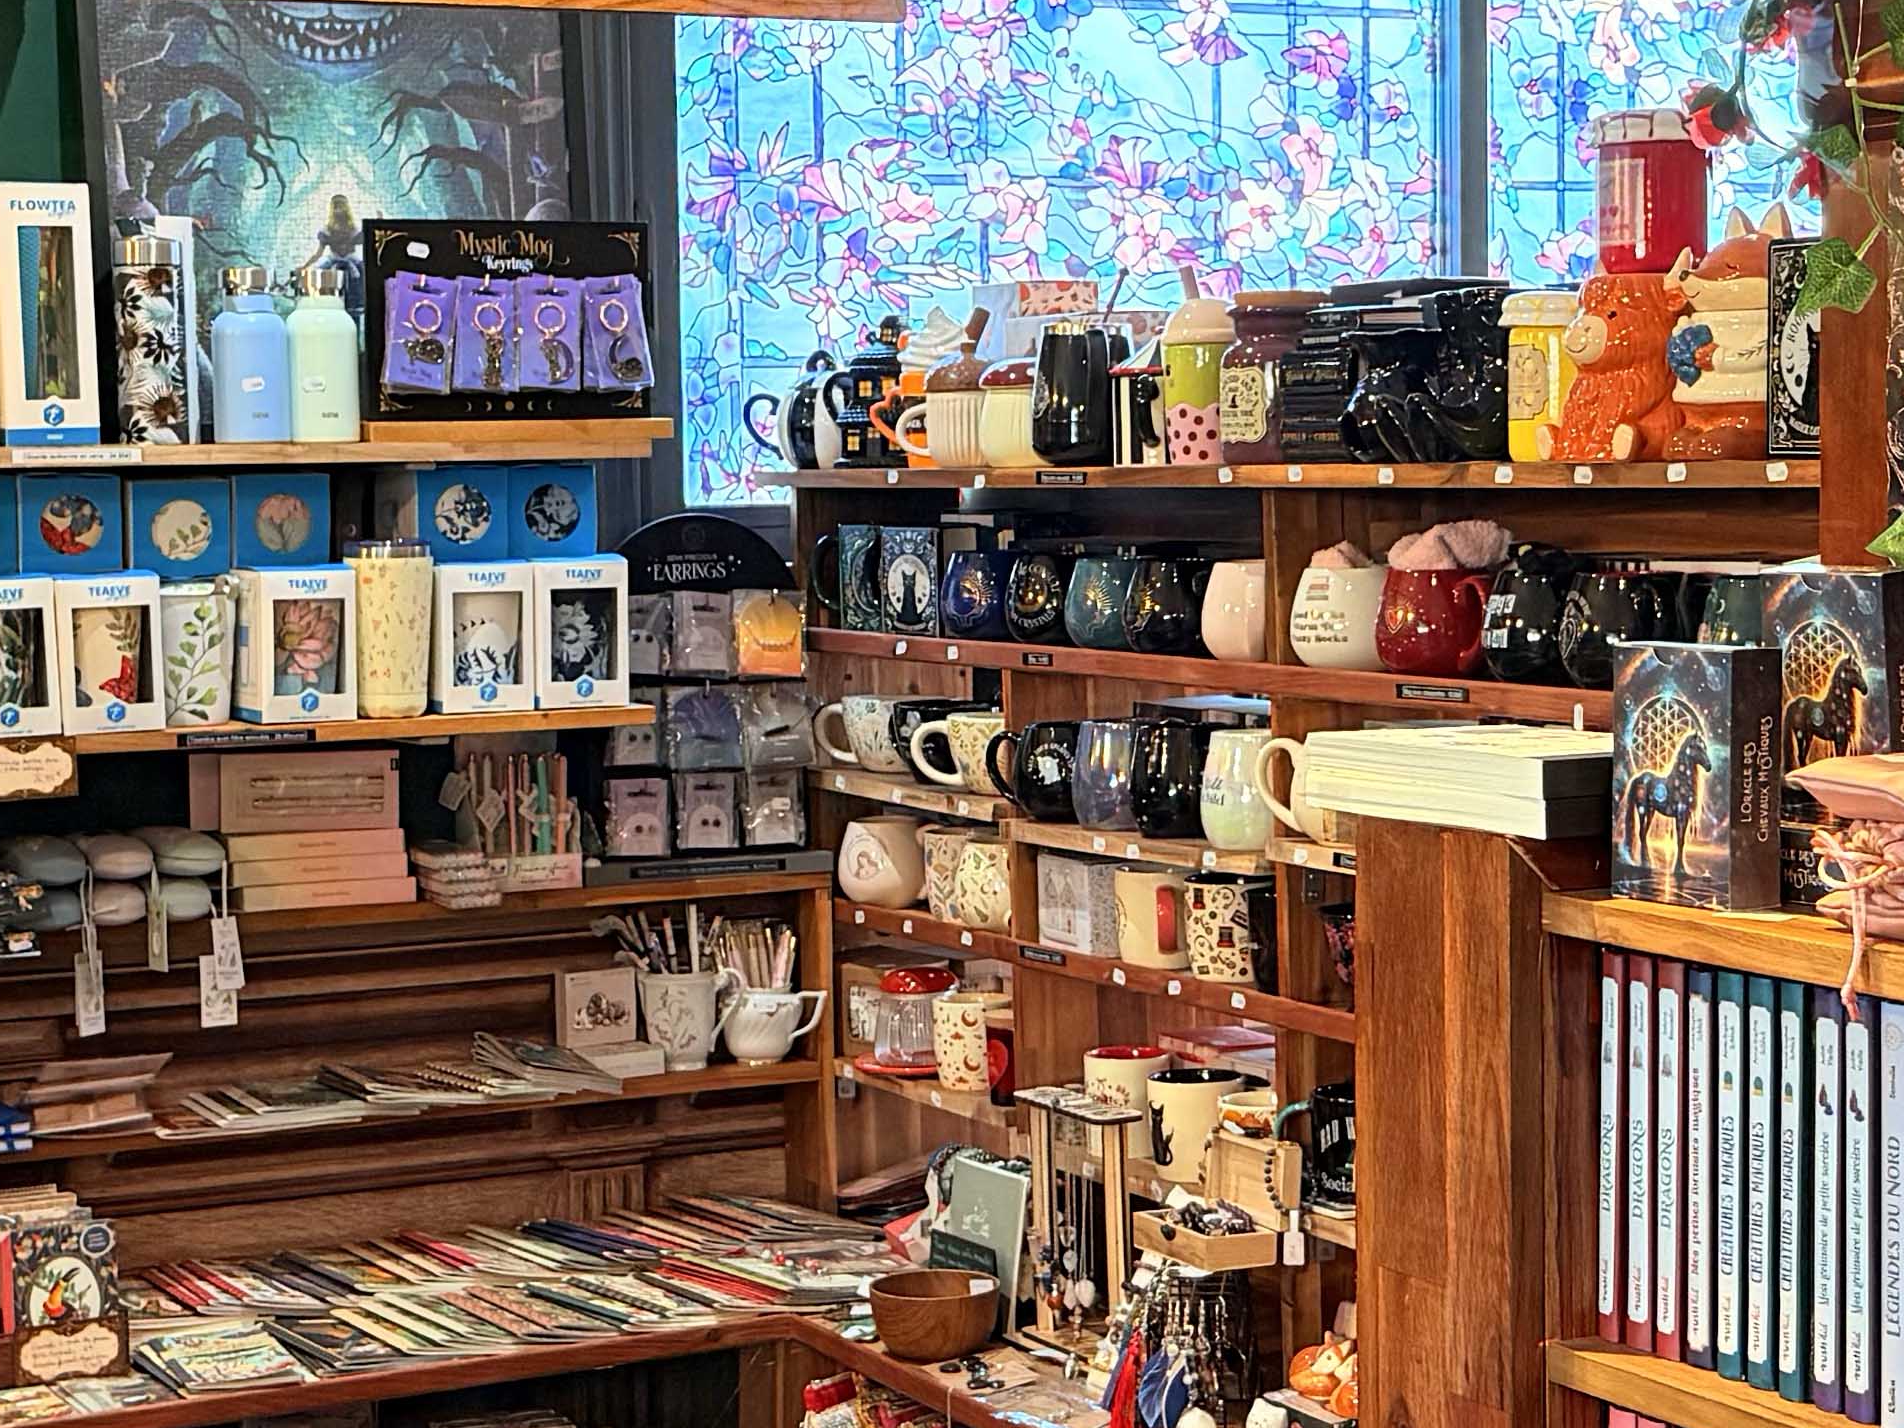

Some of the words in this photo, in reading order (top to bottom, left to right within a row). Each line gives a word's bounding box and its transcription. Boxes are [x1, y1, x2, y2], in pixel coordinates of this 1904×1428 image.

[10, 200, 76, 212] FLOWTEA
[454, 229, 511, 257] Mystic
[515, 231, 570, 266] Mog
[482, 256, 534, 273] Keyrings
[653, 561, 727, 581] EARRINGS
[1600, 1113, 1615, 1213] DRAGONS
[1630, 1119, 1644, 1220] DRAGONS
[1659, 1127, 1674, 1229] DRAGONS
[1886, 1136, 1900, 1198] NORD
[1886, 1206, 1900, 1231] DU
[1884, 1240, 1902, 1338] LÉGENDES
